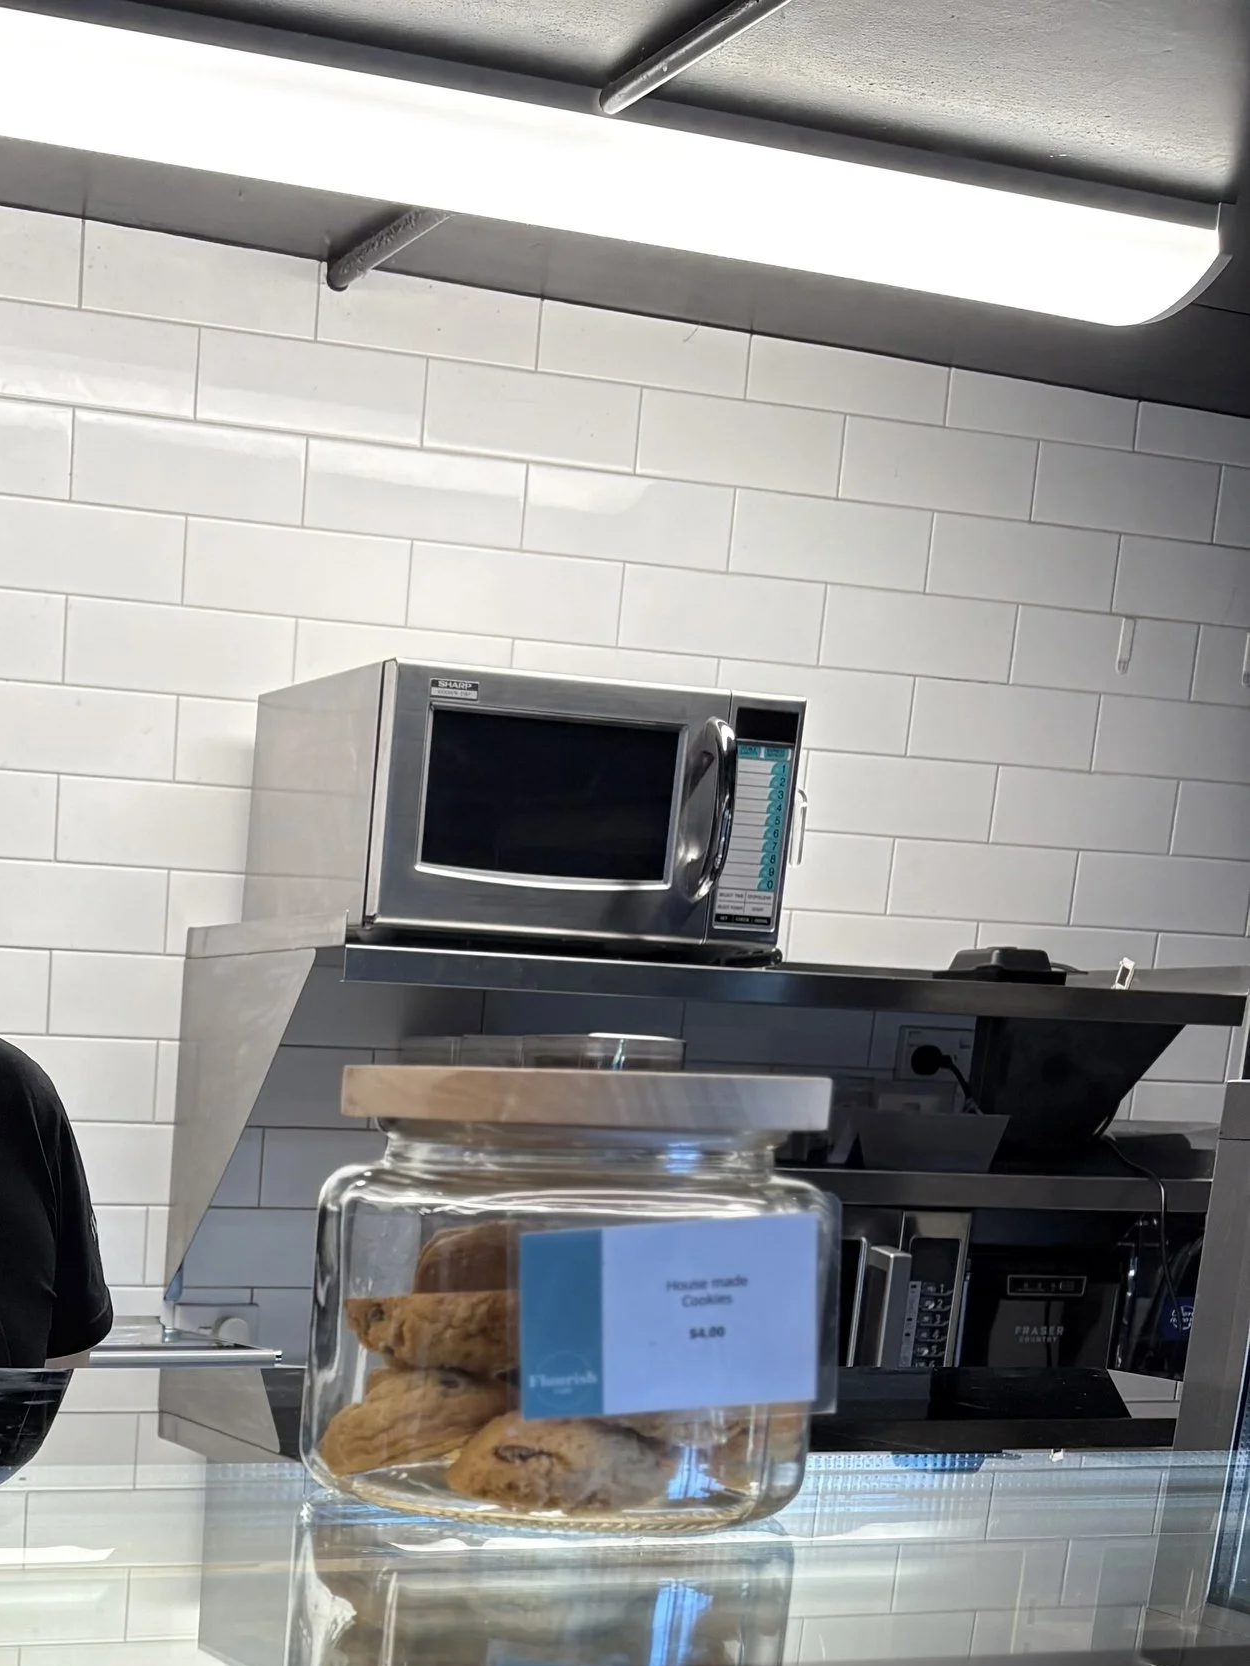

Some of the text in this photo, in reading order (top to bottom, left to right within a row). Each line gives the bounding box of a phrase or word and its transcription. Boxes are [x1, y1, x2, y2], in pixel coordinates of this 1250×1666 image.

[437, 680, 472, 690] SHARP
[666, 1273, 748, 1291] House made
[681, 1292, 733, 1307] Cookies
[689, 1325, 725, 1339] $4.00
[1015, 1326, 1064, 1336] FRASER
